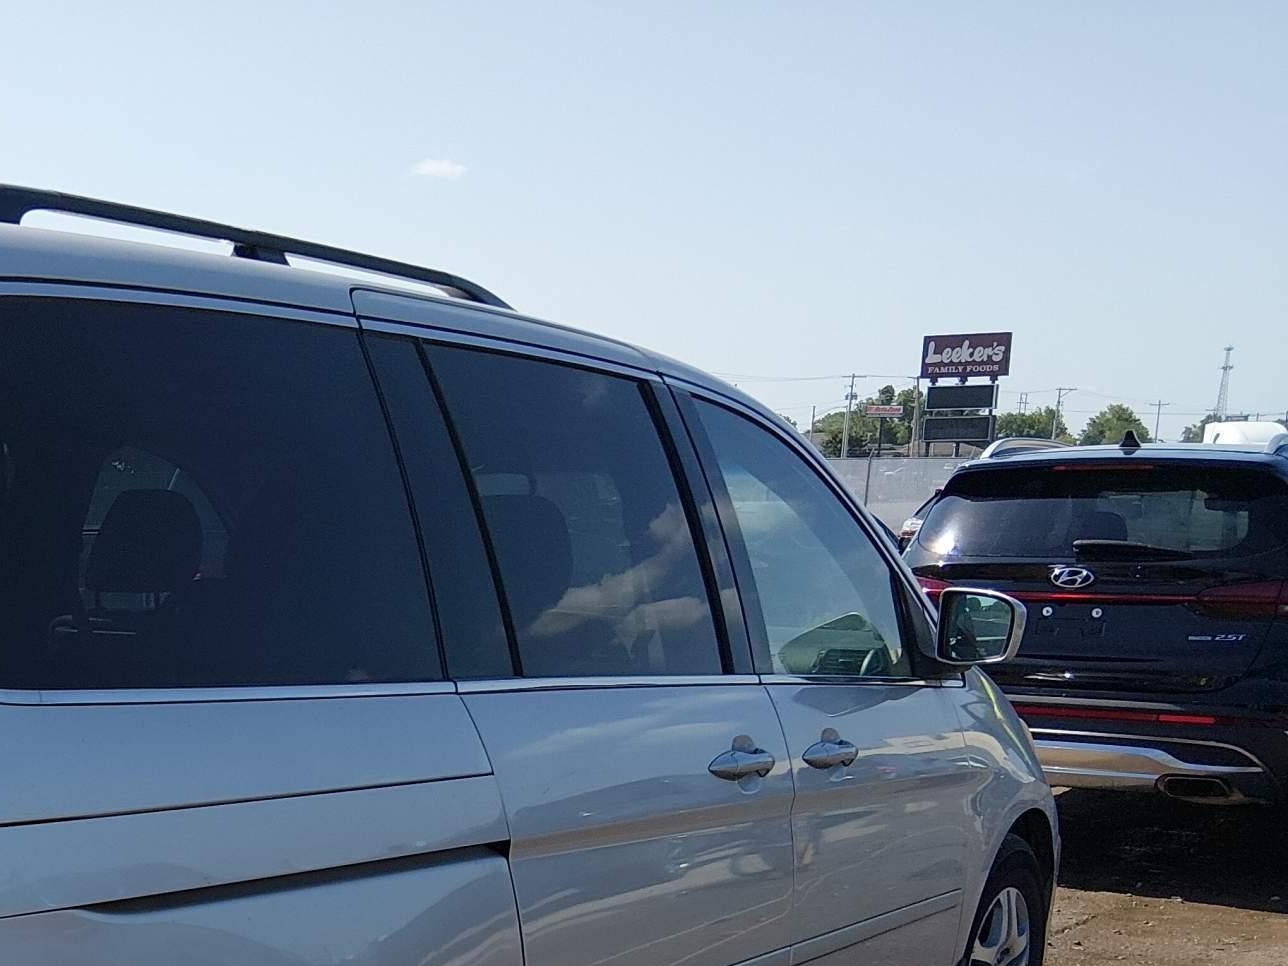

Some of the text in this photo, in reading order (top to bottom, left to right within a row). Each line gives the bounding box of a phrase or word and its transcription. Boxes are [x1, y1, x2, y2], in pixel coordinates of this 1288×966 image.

[925, 340, 1006, 364] Leeker's
[927, 364, 1000, 374] FAMILY FOODS
